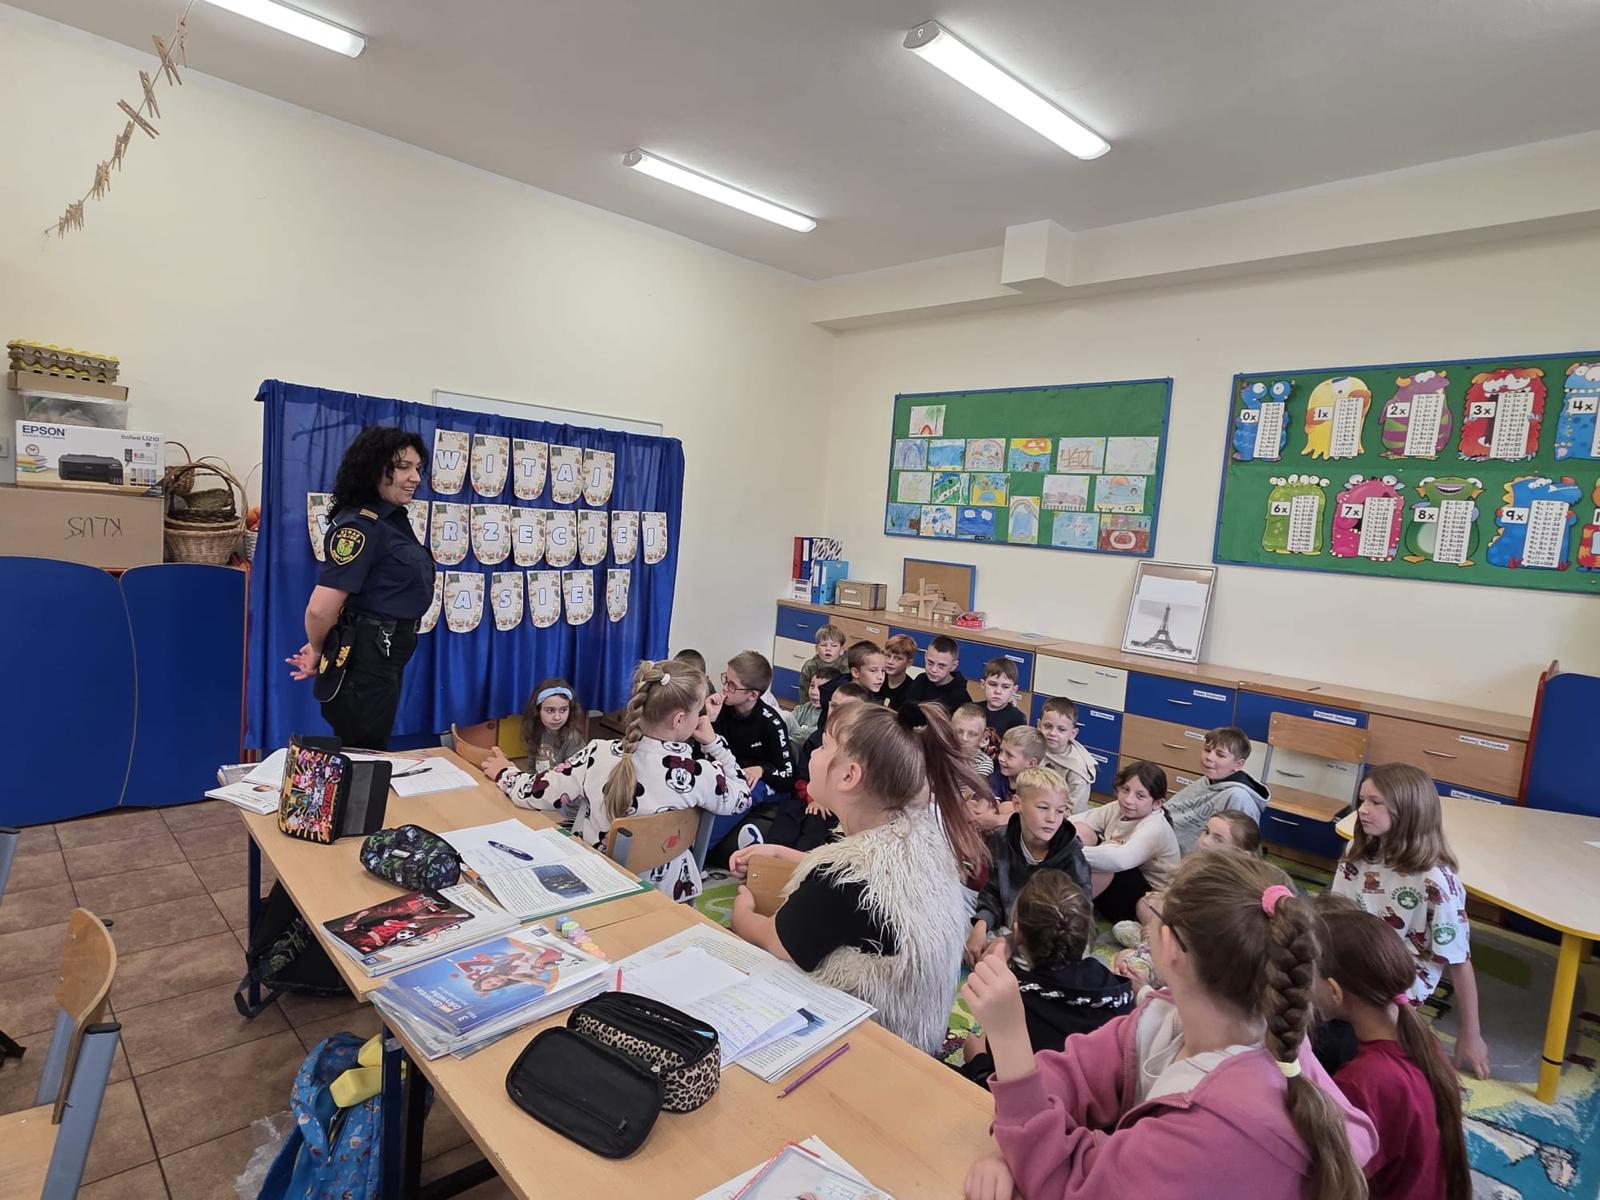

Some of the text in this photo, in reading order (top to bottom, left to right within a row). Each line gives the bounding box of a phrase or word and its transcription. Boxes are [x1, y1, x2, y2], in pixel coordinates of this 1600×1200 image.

[1390, 404, 1406, 415] 2x
[1473, 404, 1491, 415] 3x
[1573, 400, 1593, 411] 4x
[1243, 411, 1256, 421] 0x
[22, 424, 65, 437] EPSON
[436, 449, 601, 488] WITAJ
[1274, 504, 1288, 514] 6x
[1345, 506, 1360, 516] 7x
[1418, 510, 1435, 520] 8x
[1505, 510, 1524, 521] 9x
[409, 518, 655, 546] RZECIEJ
